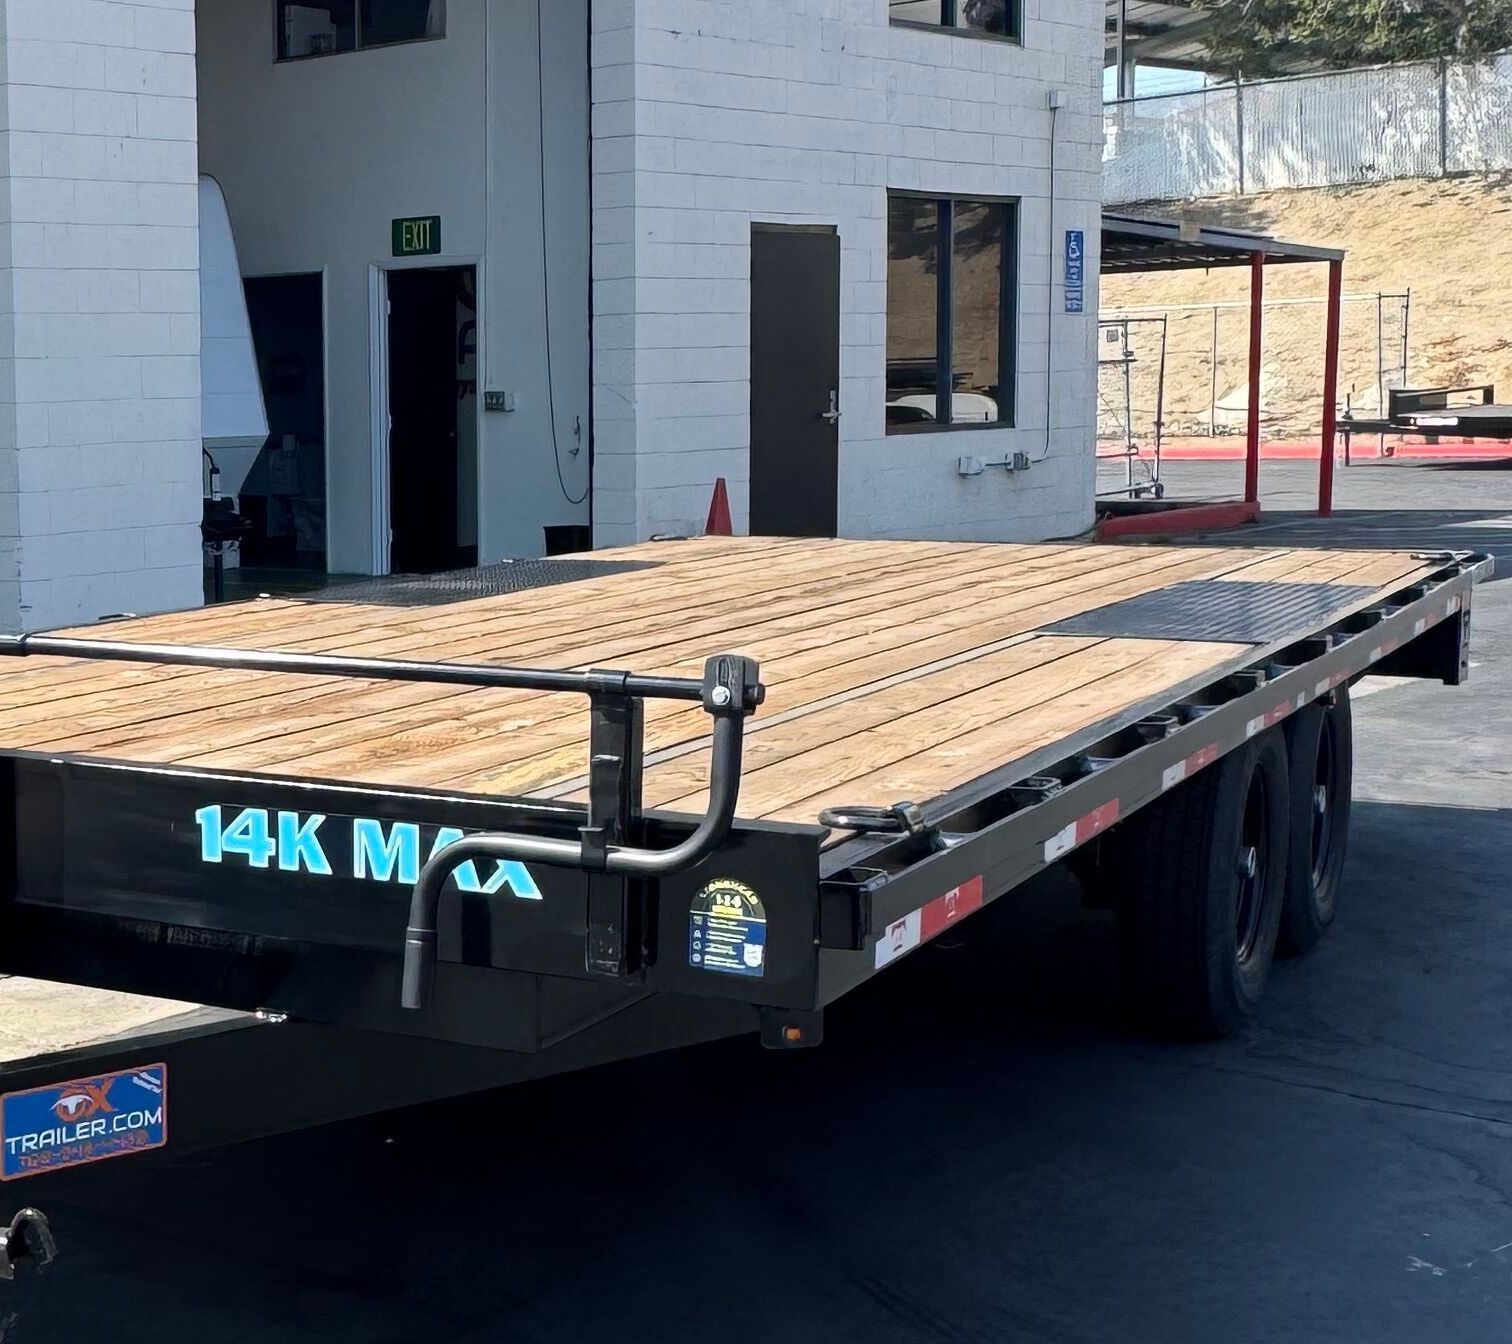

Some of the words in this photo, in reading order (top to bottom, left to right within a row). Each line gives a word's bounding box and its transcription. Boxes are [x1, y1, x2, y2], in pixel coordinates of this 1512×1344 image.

[402, 219, 432, 252] EXIT
[195, 804, 333, 876] 14K
[55, 1077, 116, 1123] OX
[4, 1106, 163, 1156] TRAILER.COM
